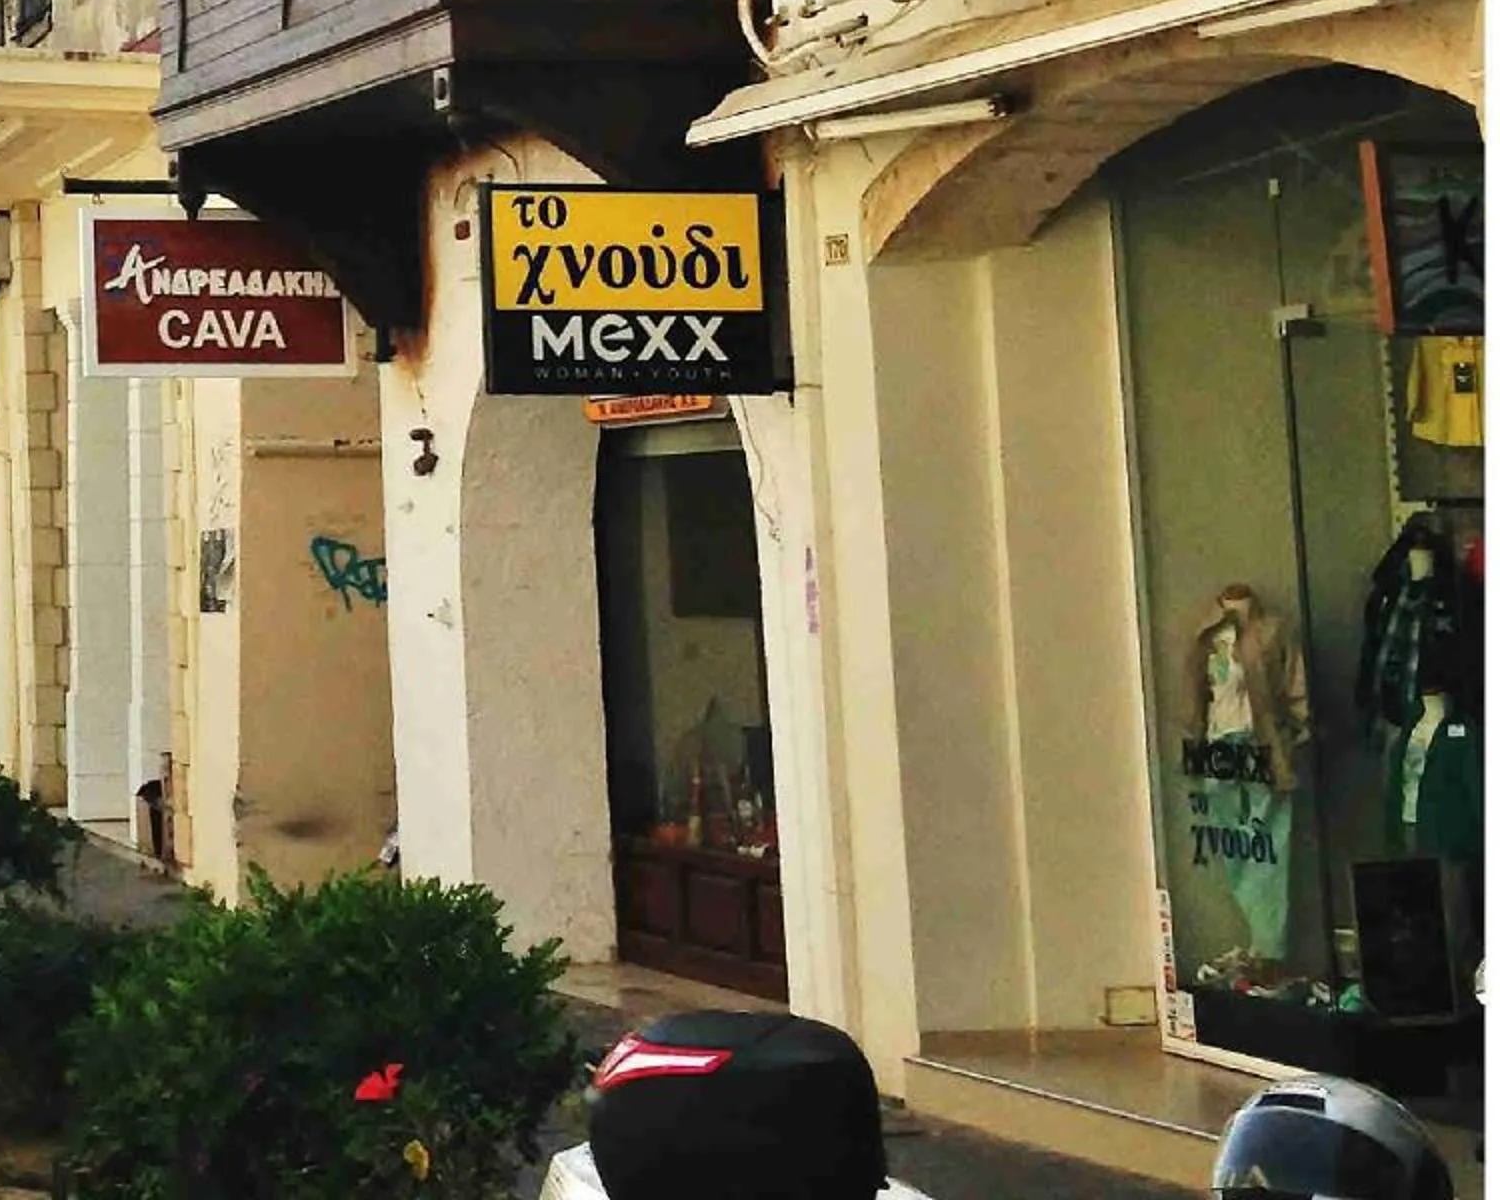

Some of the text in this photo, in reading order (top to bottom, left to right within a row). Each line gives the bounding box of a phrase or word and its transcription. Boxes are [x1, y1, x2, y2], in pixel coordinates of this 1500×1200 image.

[512, 195, 567, 229] το
[158, 309, 287, 349] CAVA
[534, 367, 731, 380] WOMAN YOUTH
